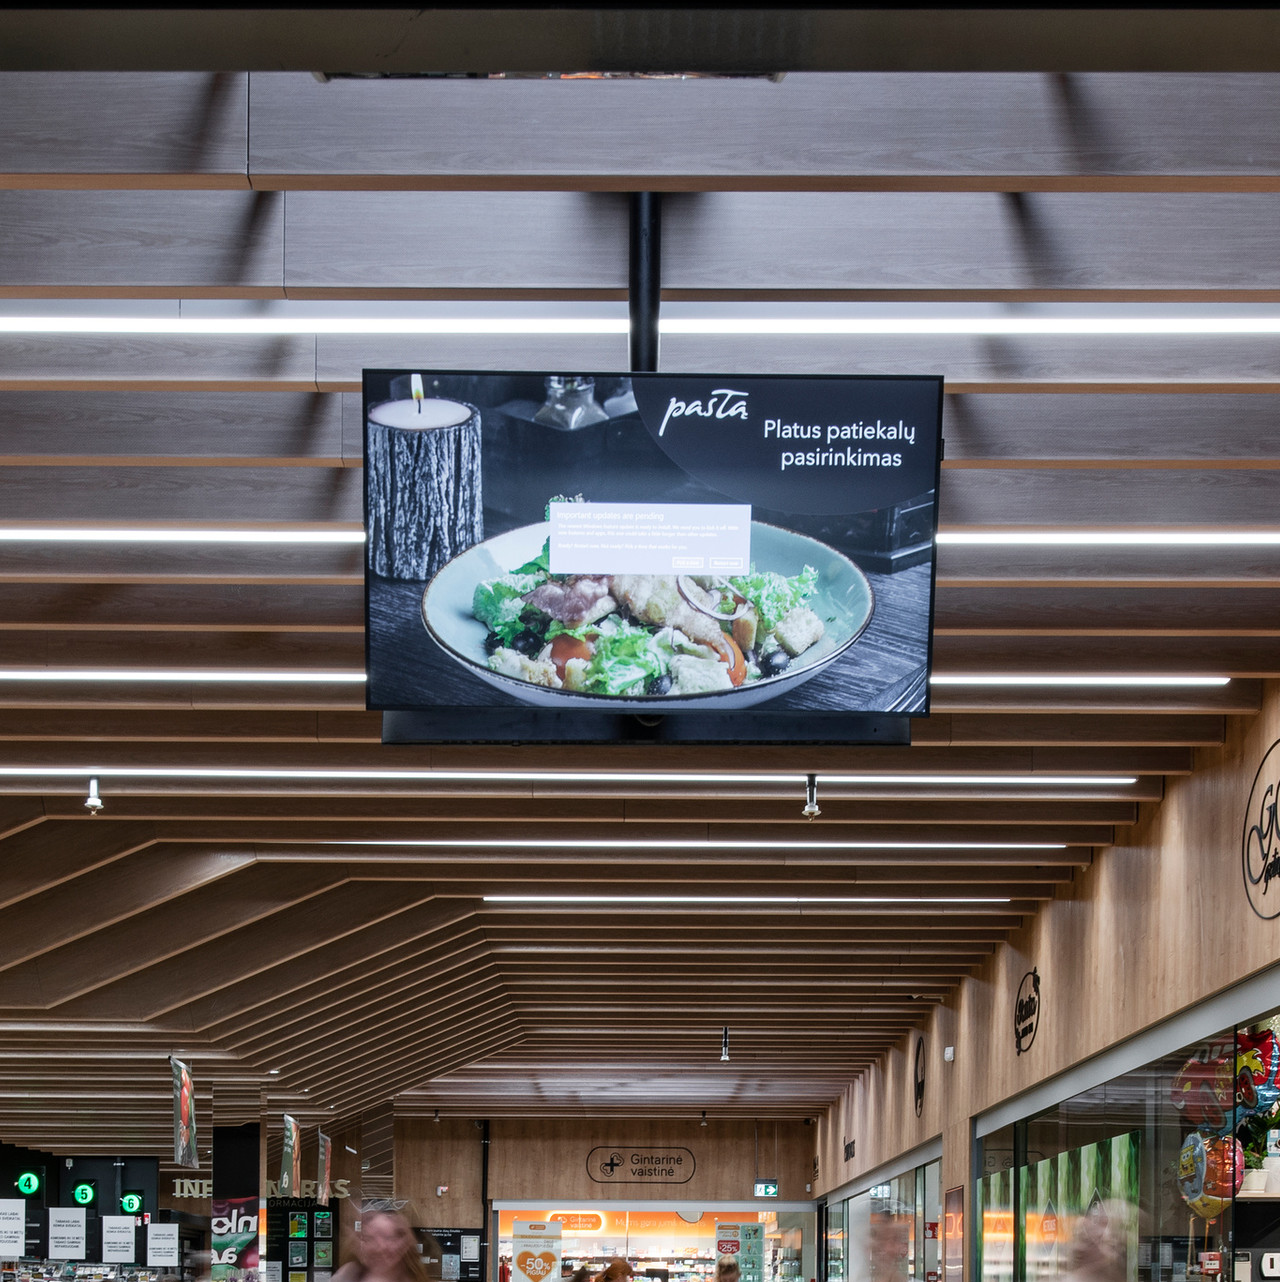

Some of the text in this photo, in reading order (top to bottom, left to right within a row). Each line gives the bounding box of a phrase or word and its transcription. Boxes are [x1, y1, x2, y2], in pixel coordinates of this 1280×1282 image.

[764, 419, 915, 444] Platus patiekalų
[781, 447, 902, 470] pasirinkimas
[631, 1153, 683, 1165] Gintarinė
[631, 1166, 674, 1176] vaistinė
[23, 1177, 32, 1189] 4
[81, 1189, 88, 1200] 5
[128, 1198, 135, 1209] 6
[520, 1257, 551, 1270] -50%
